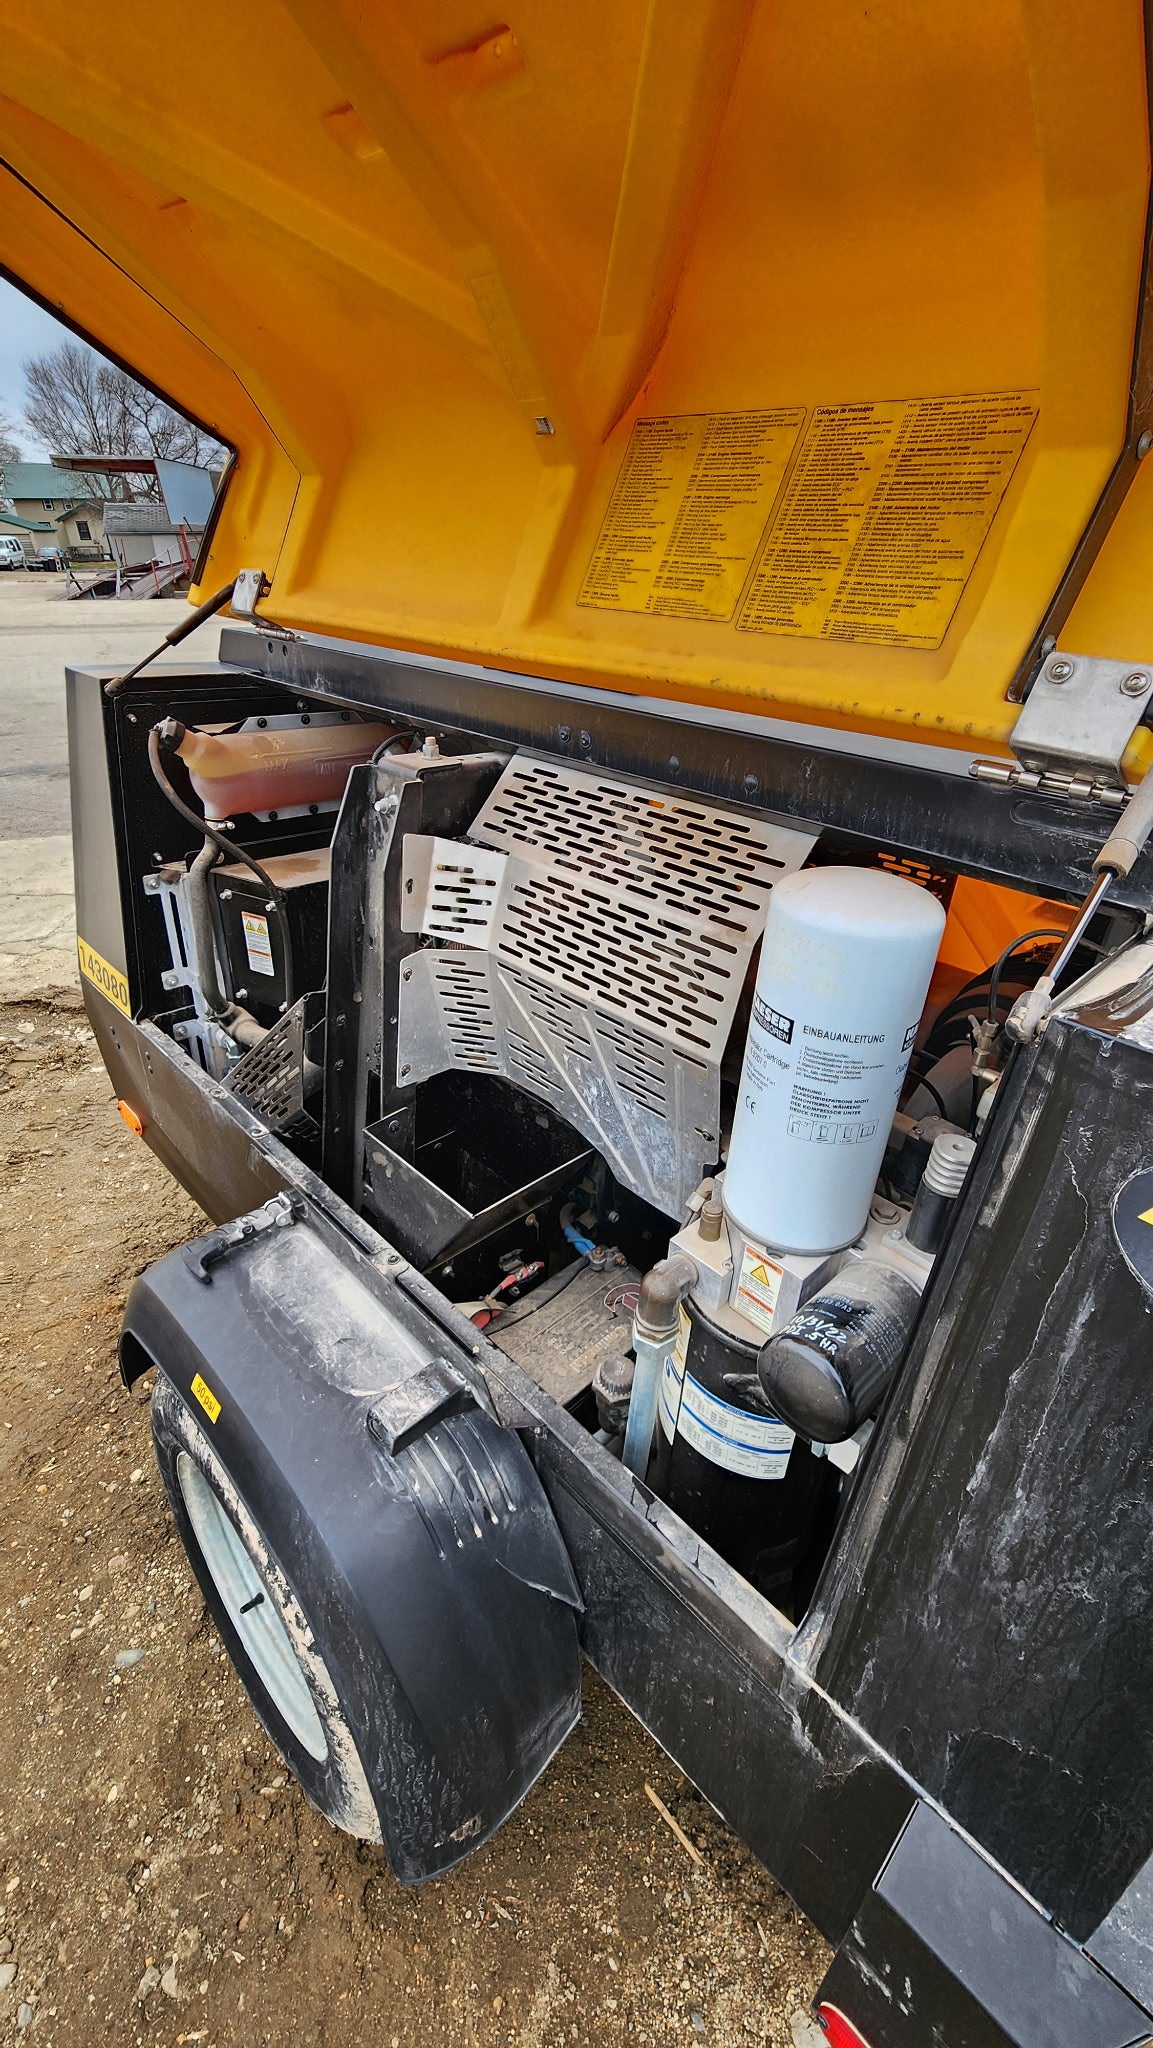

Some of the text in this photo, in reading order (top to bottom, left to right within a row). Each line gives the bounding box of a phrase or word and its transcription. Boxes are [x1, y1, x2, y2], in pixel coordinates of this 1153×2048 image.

[815, 407, 839, 416] Códigos
[846, 405, 874, 414] mensajes
[803, 1025, 885, 1044] EINBAUANLEITUNG
[794, 1084, 822, 1096] WARNUNG
[790, 1106, 808, 1116] DRUCK
[803, 1104, 841, 1115] KOMPRESSOR
[779, 1325, 806, 1335] PDI
[791, 1315, 847, 1344] 10/31/22
[196, 1382, 216, 1413] 50 psi
